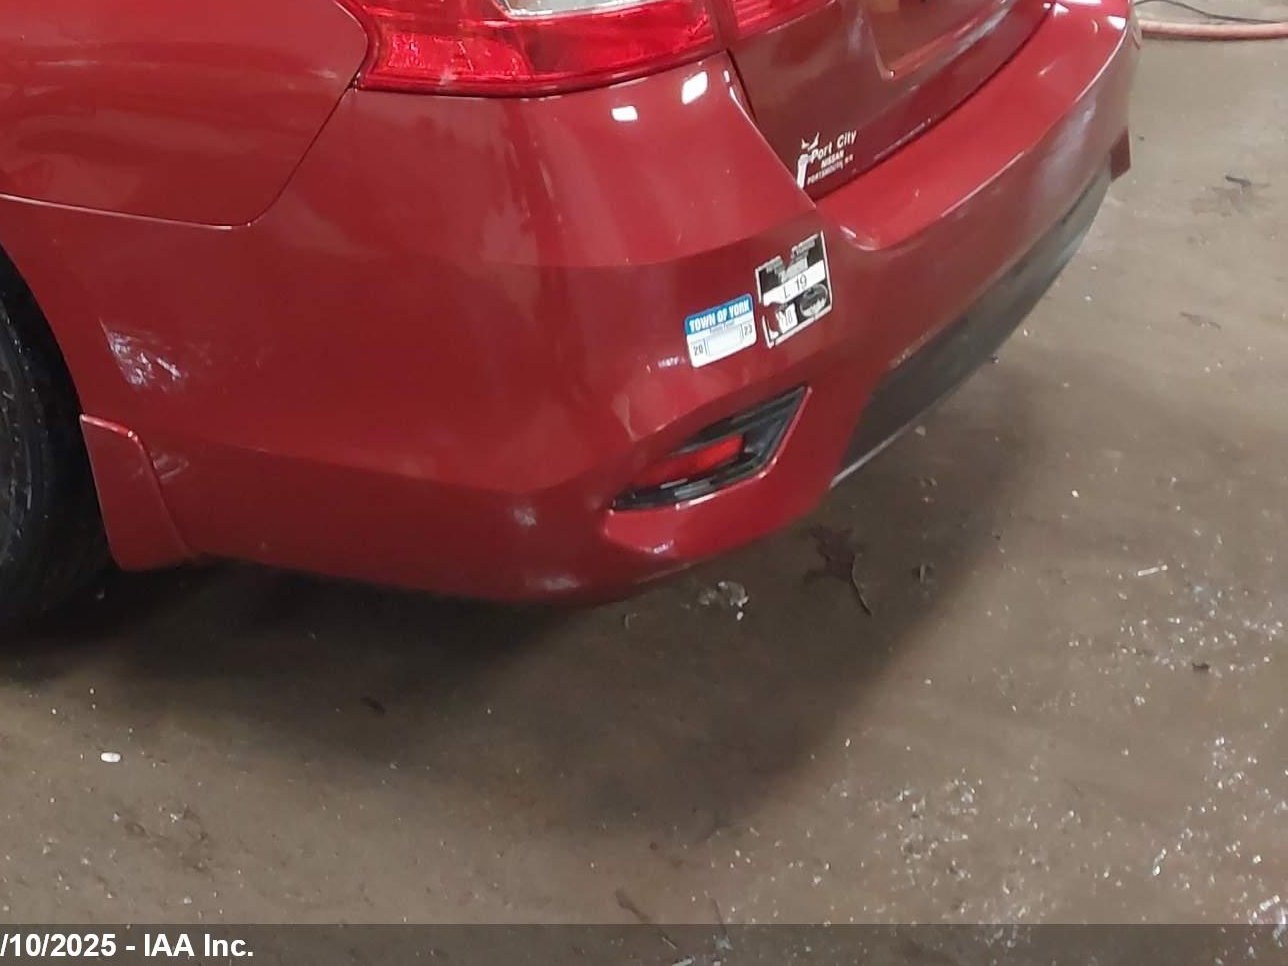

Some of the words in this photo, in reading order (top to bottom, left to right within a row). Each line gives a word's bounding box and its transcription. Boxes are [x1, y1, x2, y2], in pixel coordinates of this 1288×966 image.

[795, 273, 808, 292] 19
[688, 311, 716, 333] TOWN
[716, 307, 728, 323] OF
[728, 298, 750, 318] YORK
